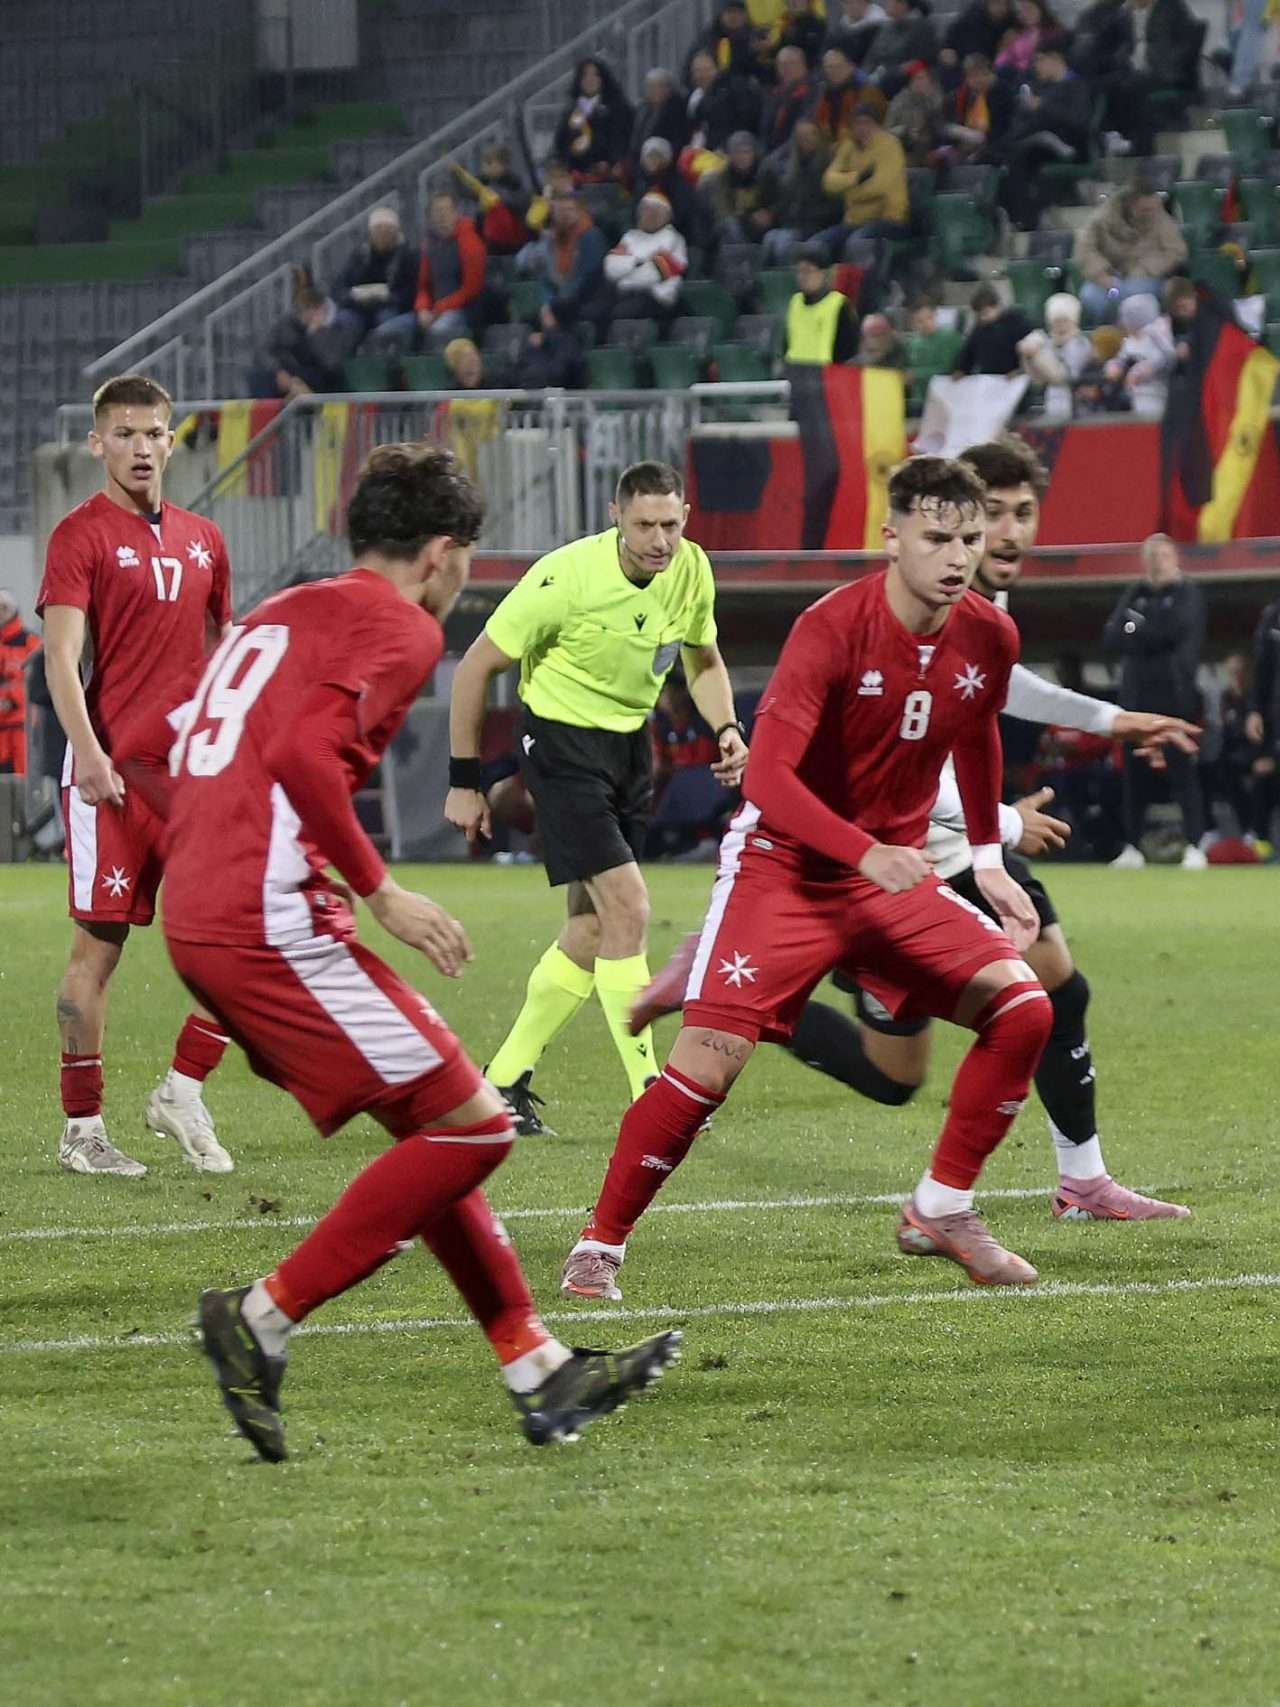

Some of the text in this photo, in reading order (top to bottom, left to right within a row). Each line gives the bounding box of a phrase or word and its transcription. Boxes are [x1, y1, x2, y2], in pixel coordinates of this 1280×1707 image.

[151, 556, 183, 602] 17
[166, 622, 290, 777] 19
[899, 690, 933, 740] 8
